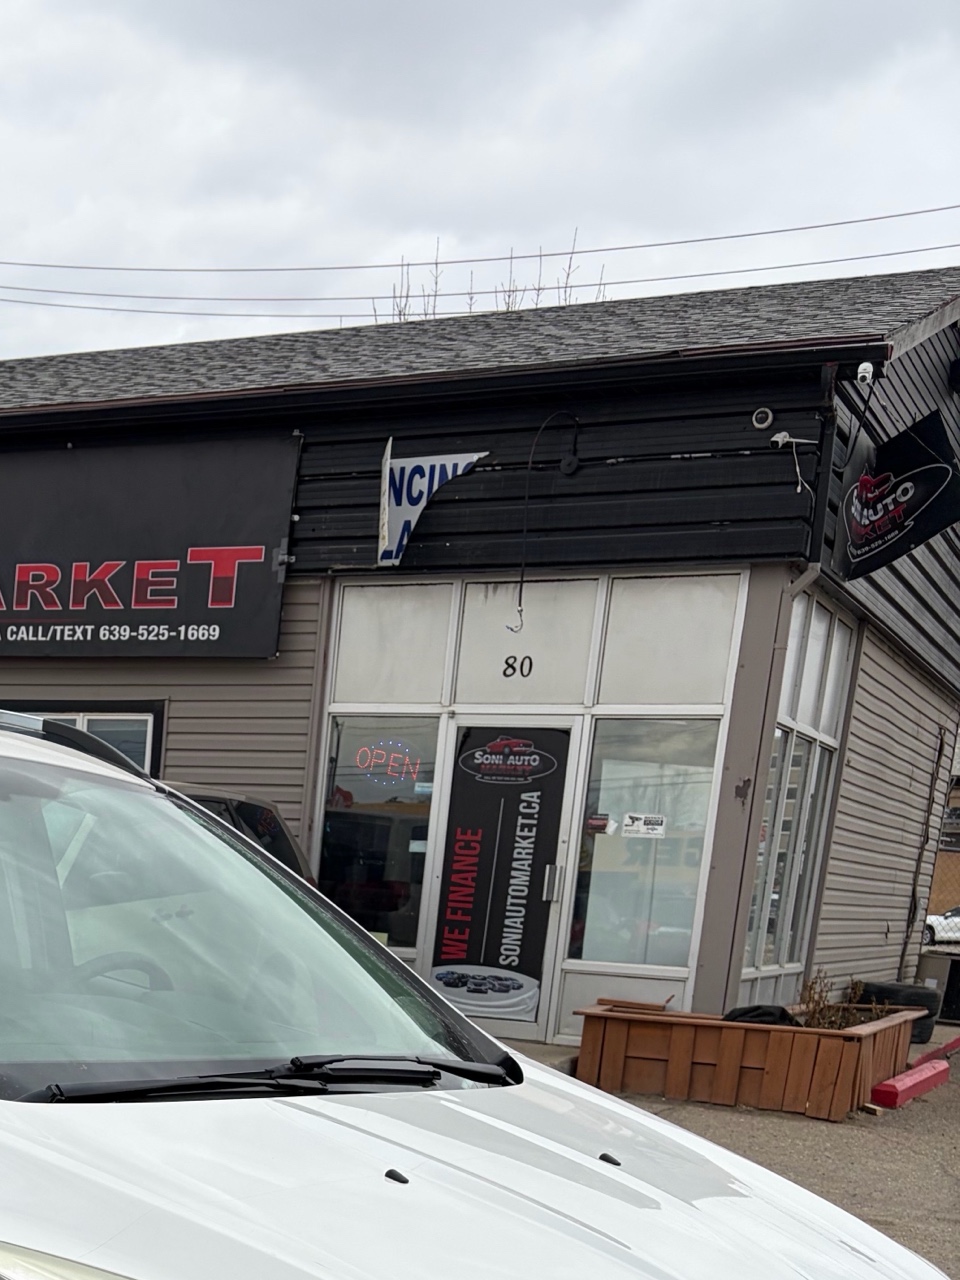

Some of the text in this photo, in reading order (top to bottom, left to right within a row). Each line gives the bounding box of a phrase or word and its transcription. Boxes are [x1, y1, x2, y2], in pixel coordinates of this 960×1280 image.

[6, 625, 95, 642] CALL/TEXT
[98, 624, 221, 642] 639-525-1669
[502, 655, 533, 678] 80
[356, 747, 420, 781] OPEN
[473, 751, 540, 766] SONI AUTO
[498, 790, 542, 966] SONIAUTOMARKET.CA
[441, 826, 483, 960] WE FINANCE
